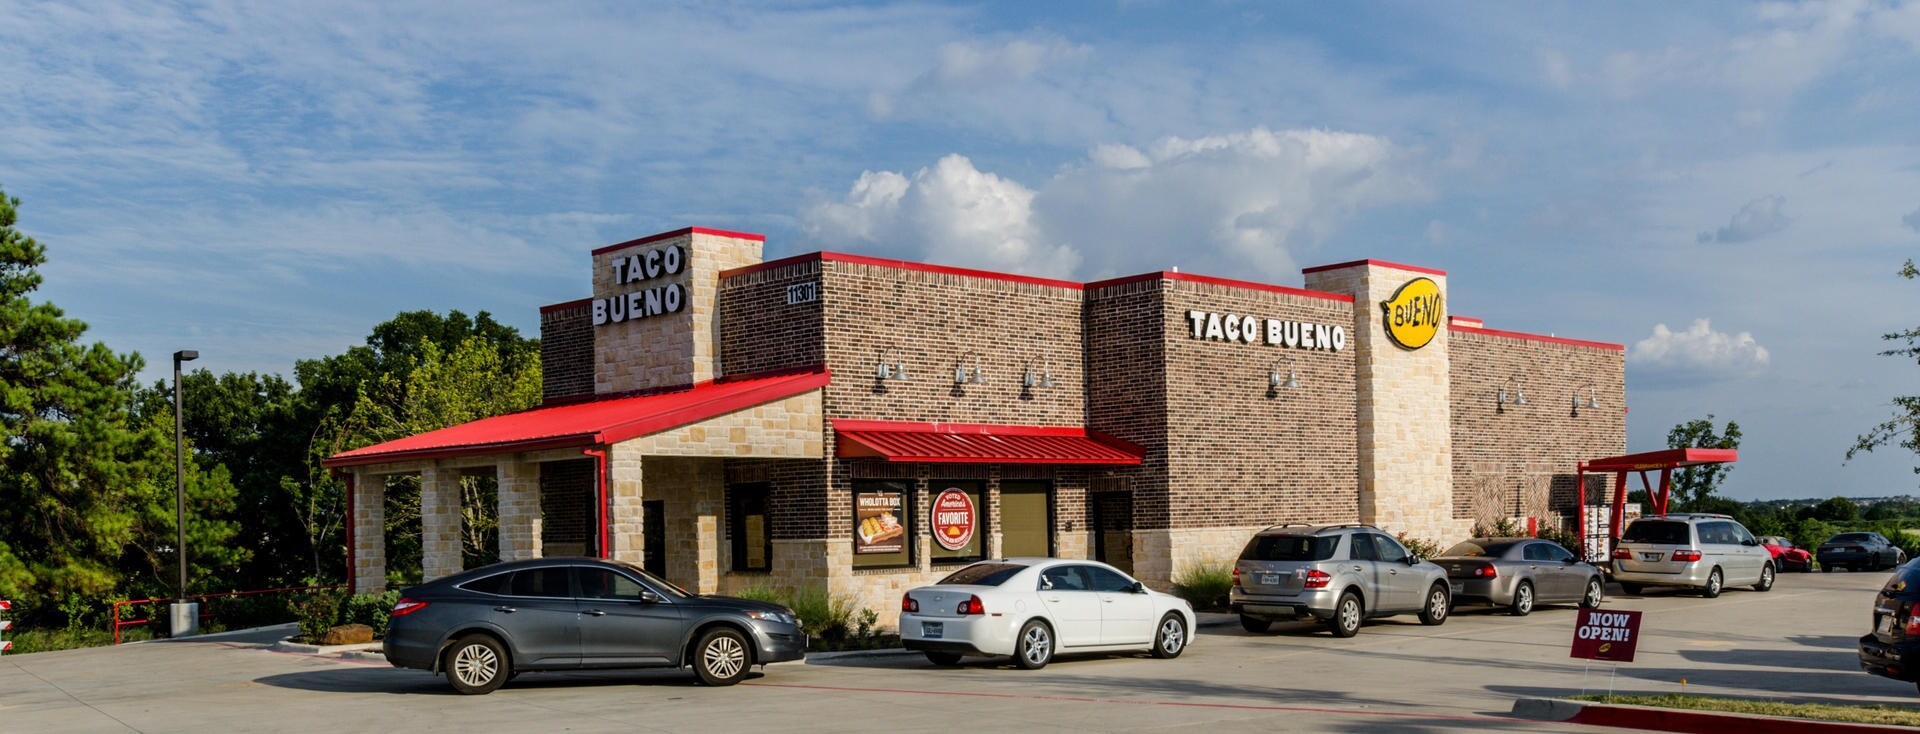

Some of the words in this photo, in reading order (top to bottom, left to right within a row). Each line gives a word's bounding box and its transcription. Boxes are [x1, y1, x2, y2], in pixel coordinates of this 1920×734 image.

[612, 245, 682, 284] TACO
[789, 284, 814, 303] 11301
[592, 283, 682, 326] BUENO
[1394, 292, 1442, 328] BUENO
[1189, 311, 1257, 343] TACO
[1265, 319, 1345, 351] BUENO
[859, 497, 888, 506] WHOLOTTA
[889, 497, 901, 506] BOX
[938, 512, 969, 525] FAVORITE
[1588, 612, 1630, 627] NOW
[1578, 626, 1630, 642] OPEN!
